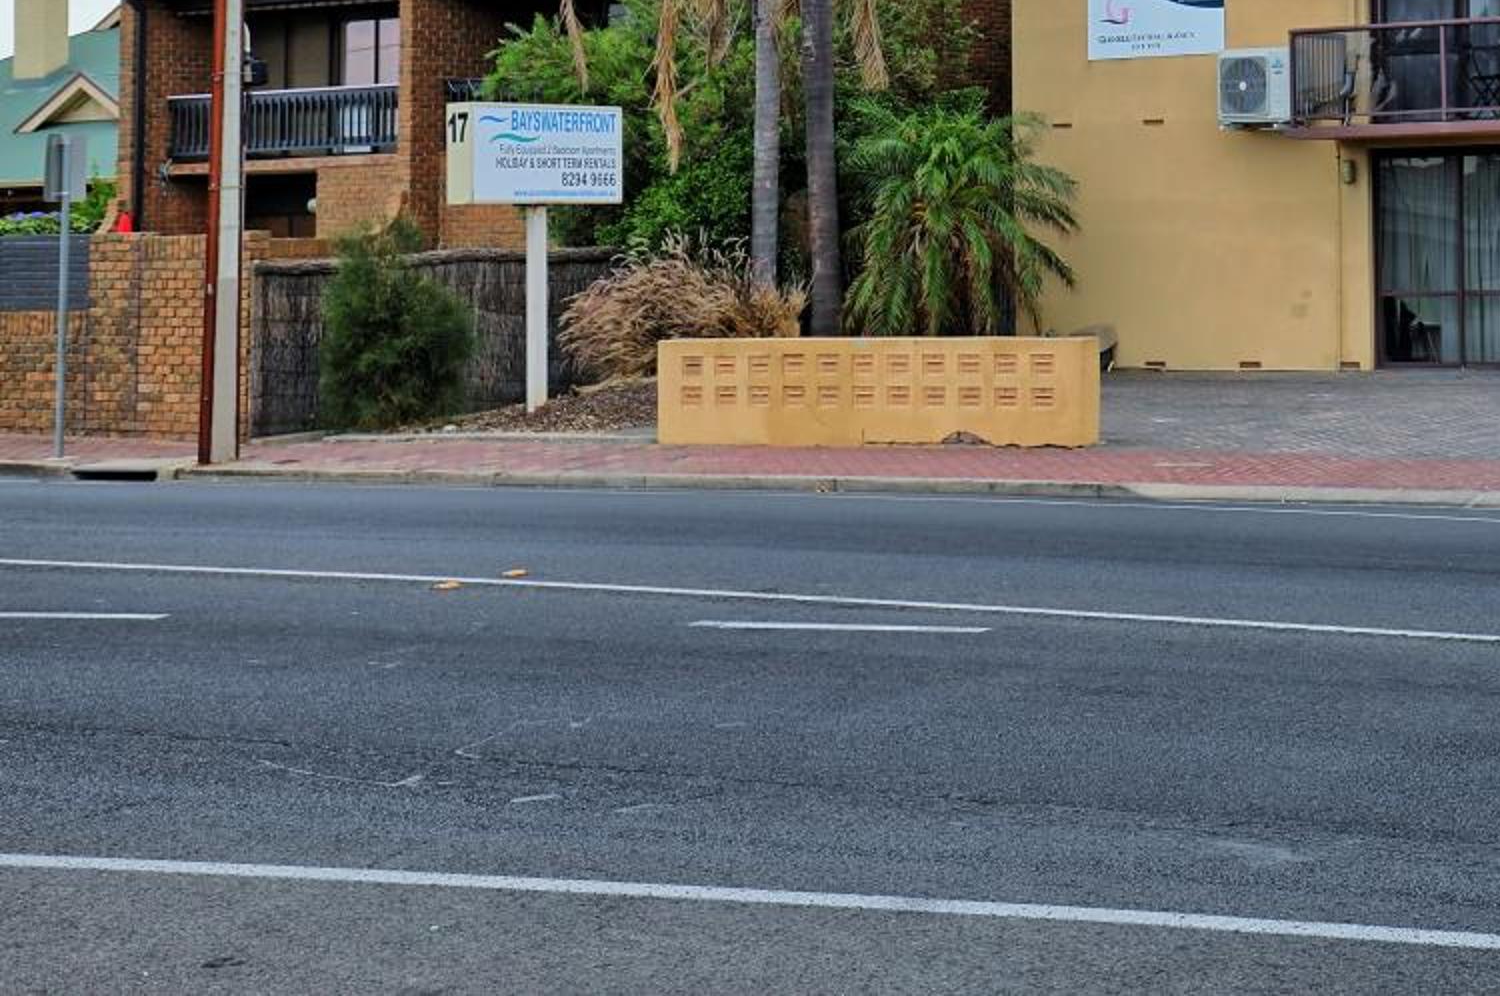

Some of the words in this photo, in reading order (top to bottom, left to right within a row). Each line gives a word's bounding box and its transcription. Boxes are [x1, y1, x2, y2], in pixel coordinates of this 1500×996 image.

[448, 112, 468, 143] 17
[511, 110, 617, 133] BAYSWATERFRONT
[496, 157, 528, 169] HOLIDAY
[583, 158, 617, 169] RENTALS
[561, 172, 587, 187] 8294
